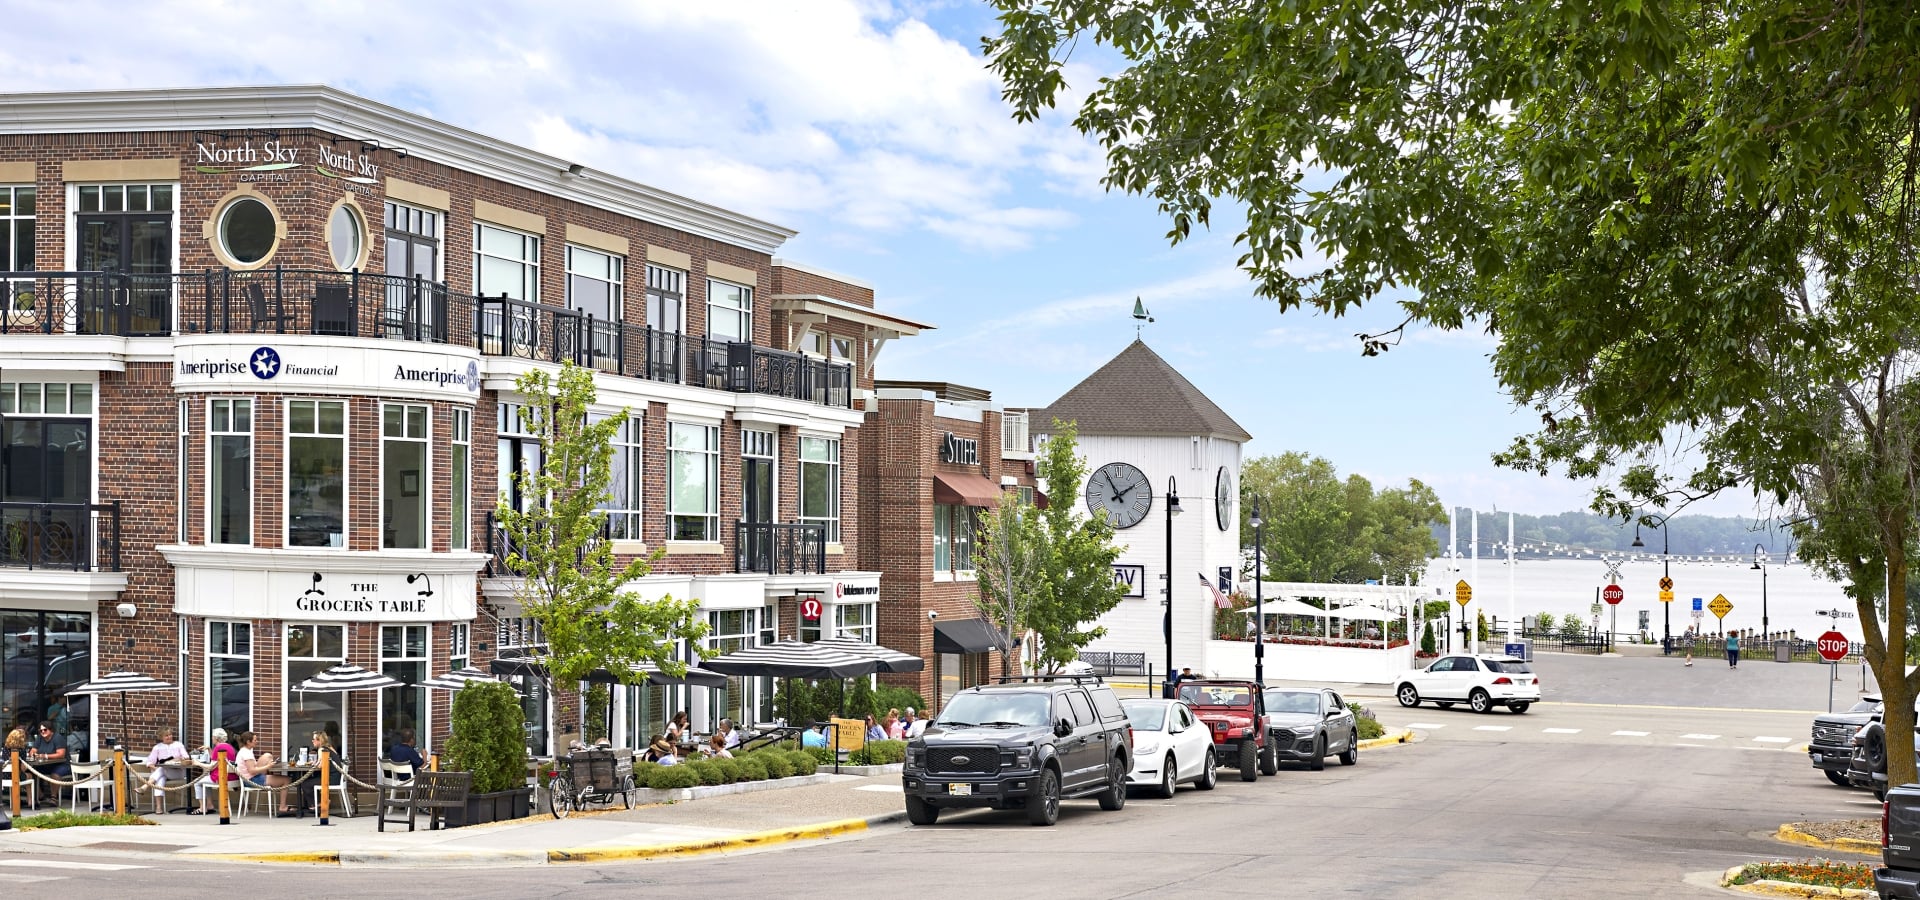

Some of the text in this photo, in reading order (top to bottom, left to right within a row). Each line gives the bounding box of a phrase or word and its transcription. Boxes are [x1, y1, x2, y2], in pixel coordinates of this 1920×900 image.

[197, 141, 299, 164] North Sky
[318, 144, 379, 181] North Sky
[240, 174, 291, 182] CAPITAL
[344, 183, 374, 197] CAPITAL
[180, 358, 339, 378] Ameriprise Financial
[394, 364, 466, 388] Ameriprise
[947, 431, 981, 466] STIFEL
[351, 583, 379, 592] THE
[1604, 590, 1623, 599] STOP
[296, 596, 426, 612] GROCER'S TABLE
[1819, 639, 1847, 652] STOP
